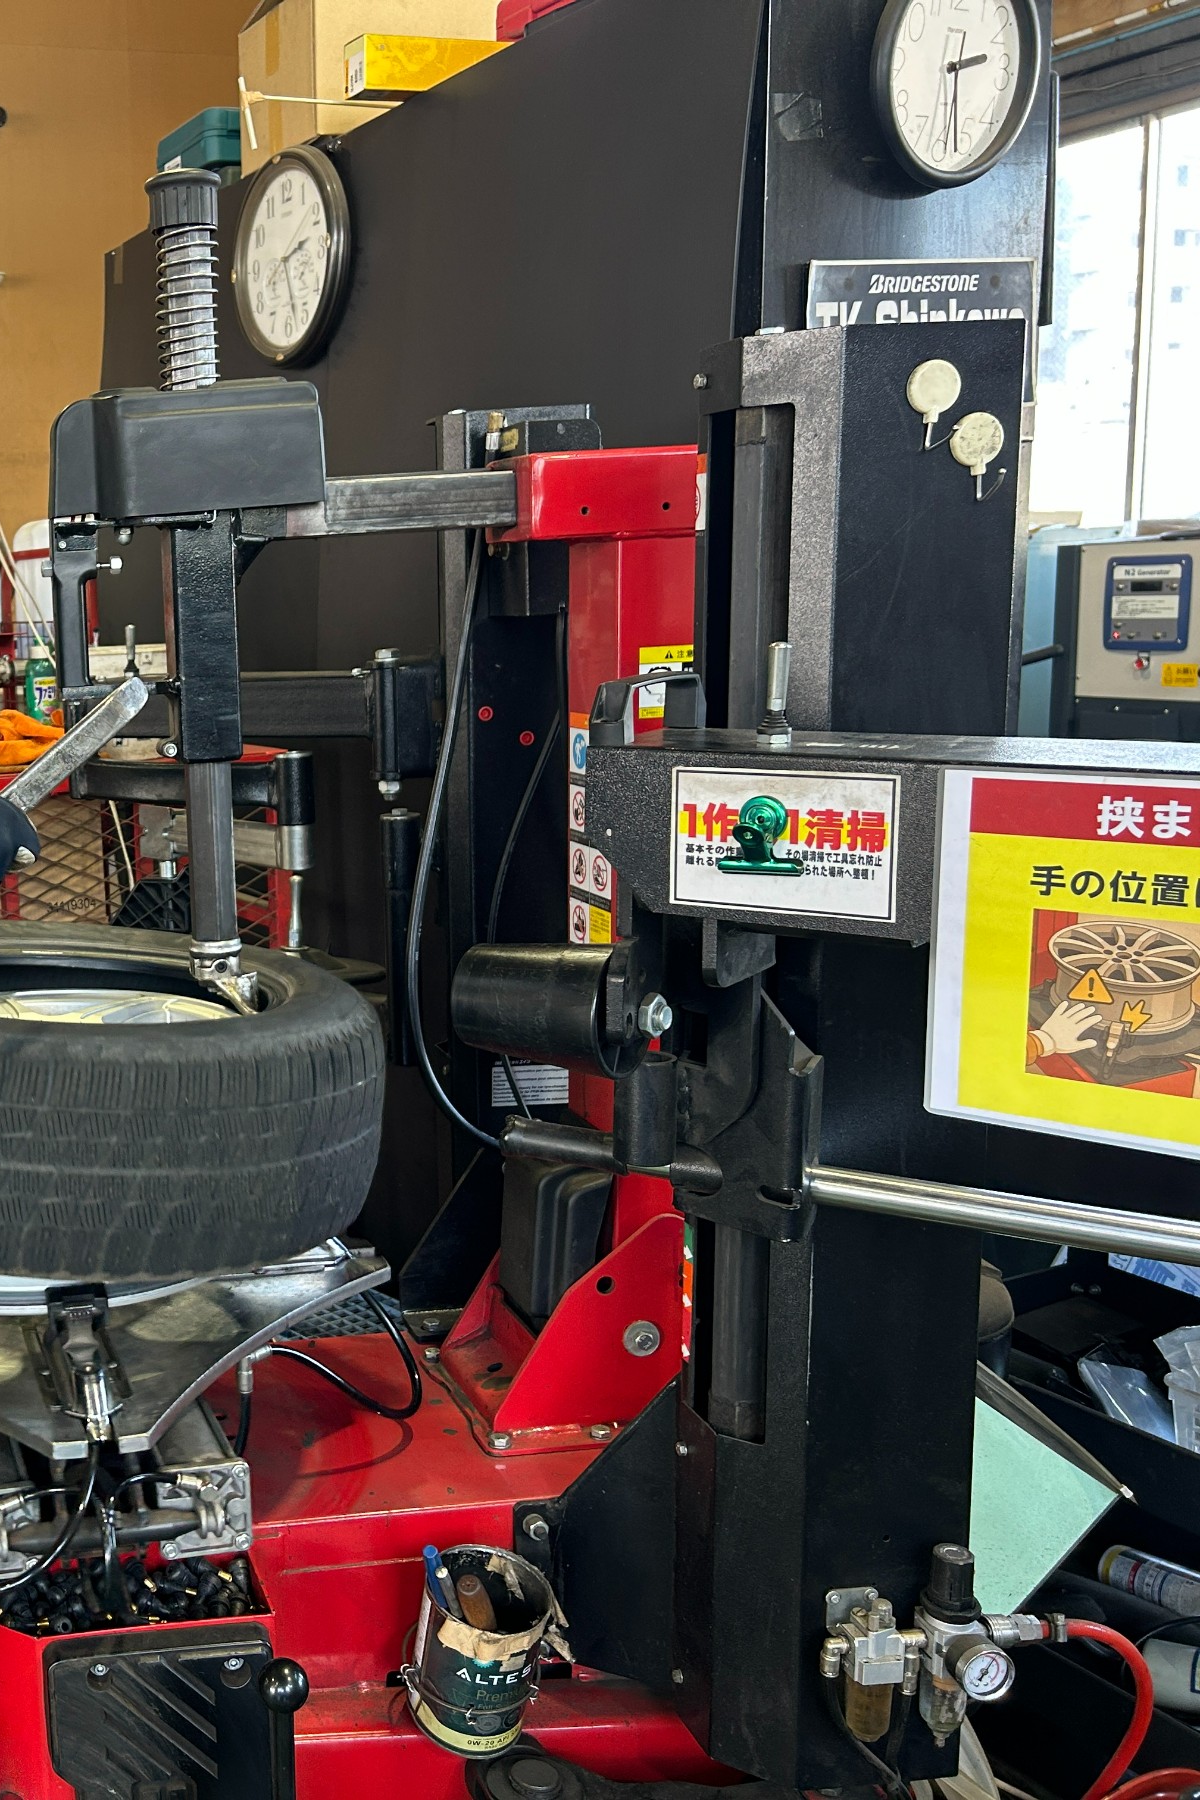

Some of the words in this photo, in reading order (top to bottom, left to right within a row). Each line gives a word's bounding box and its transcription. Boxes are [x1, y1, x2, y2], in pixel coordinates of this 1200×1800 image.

[990, 5, 1009, 45] 2
[994, 53, 1010, 91] 3
[979, 95, 996, 133] 4
[914, 115, 929, 149] 7
[957, 117, 975, 155] 5
[280, 178, 293, 204] 12
[266, 195, 275, 219] 11
[312, 202, 321, 226] 2
[253, 223, 266, 249] 10
[252, 259, 261, 282] 9
[313, 271, 321, 296] 4
[868, 273, 980, 294] BRIDGESTONE
[256, 291, 264, 315] 8
[301, 300, 309, 326] 5
[269, 310, 277, 335] 7
[284, 315, 293, 339] 6
[682, 802, 886, 853] 1作1清掃
[1096, 795, 1192, 839] 挟ま
[1030, 865, 1200, 908] 手の位置
